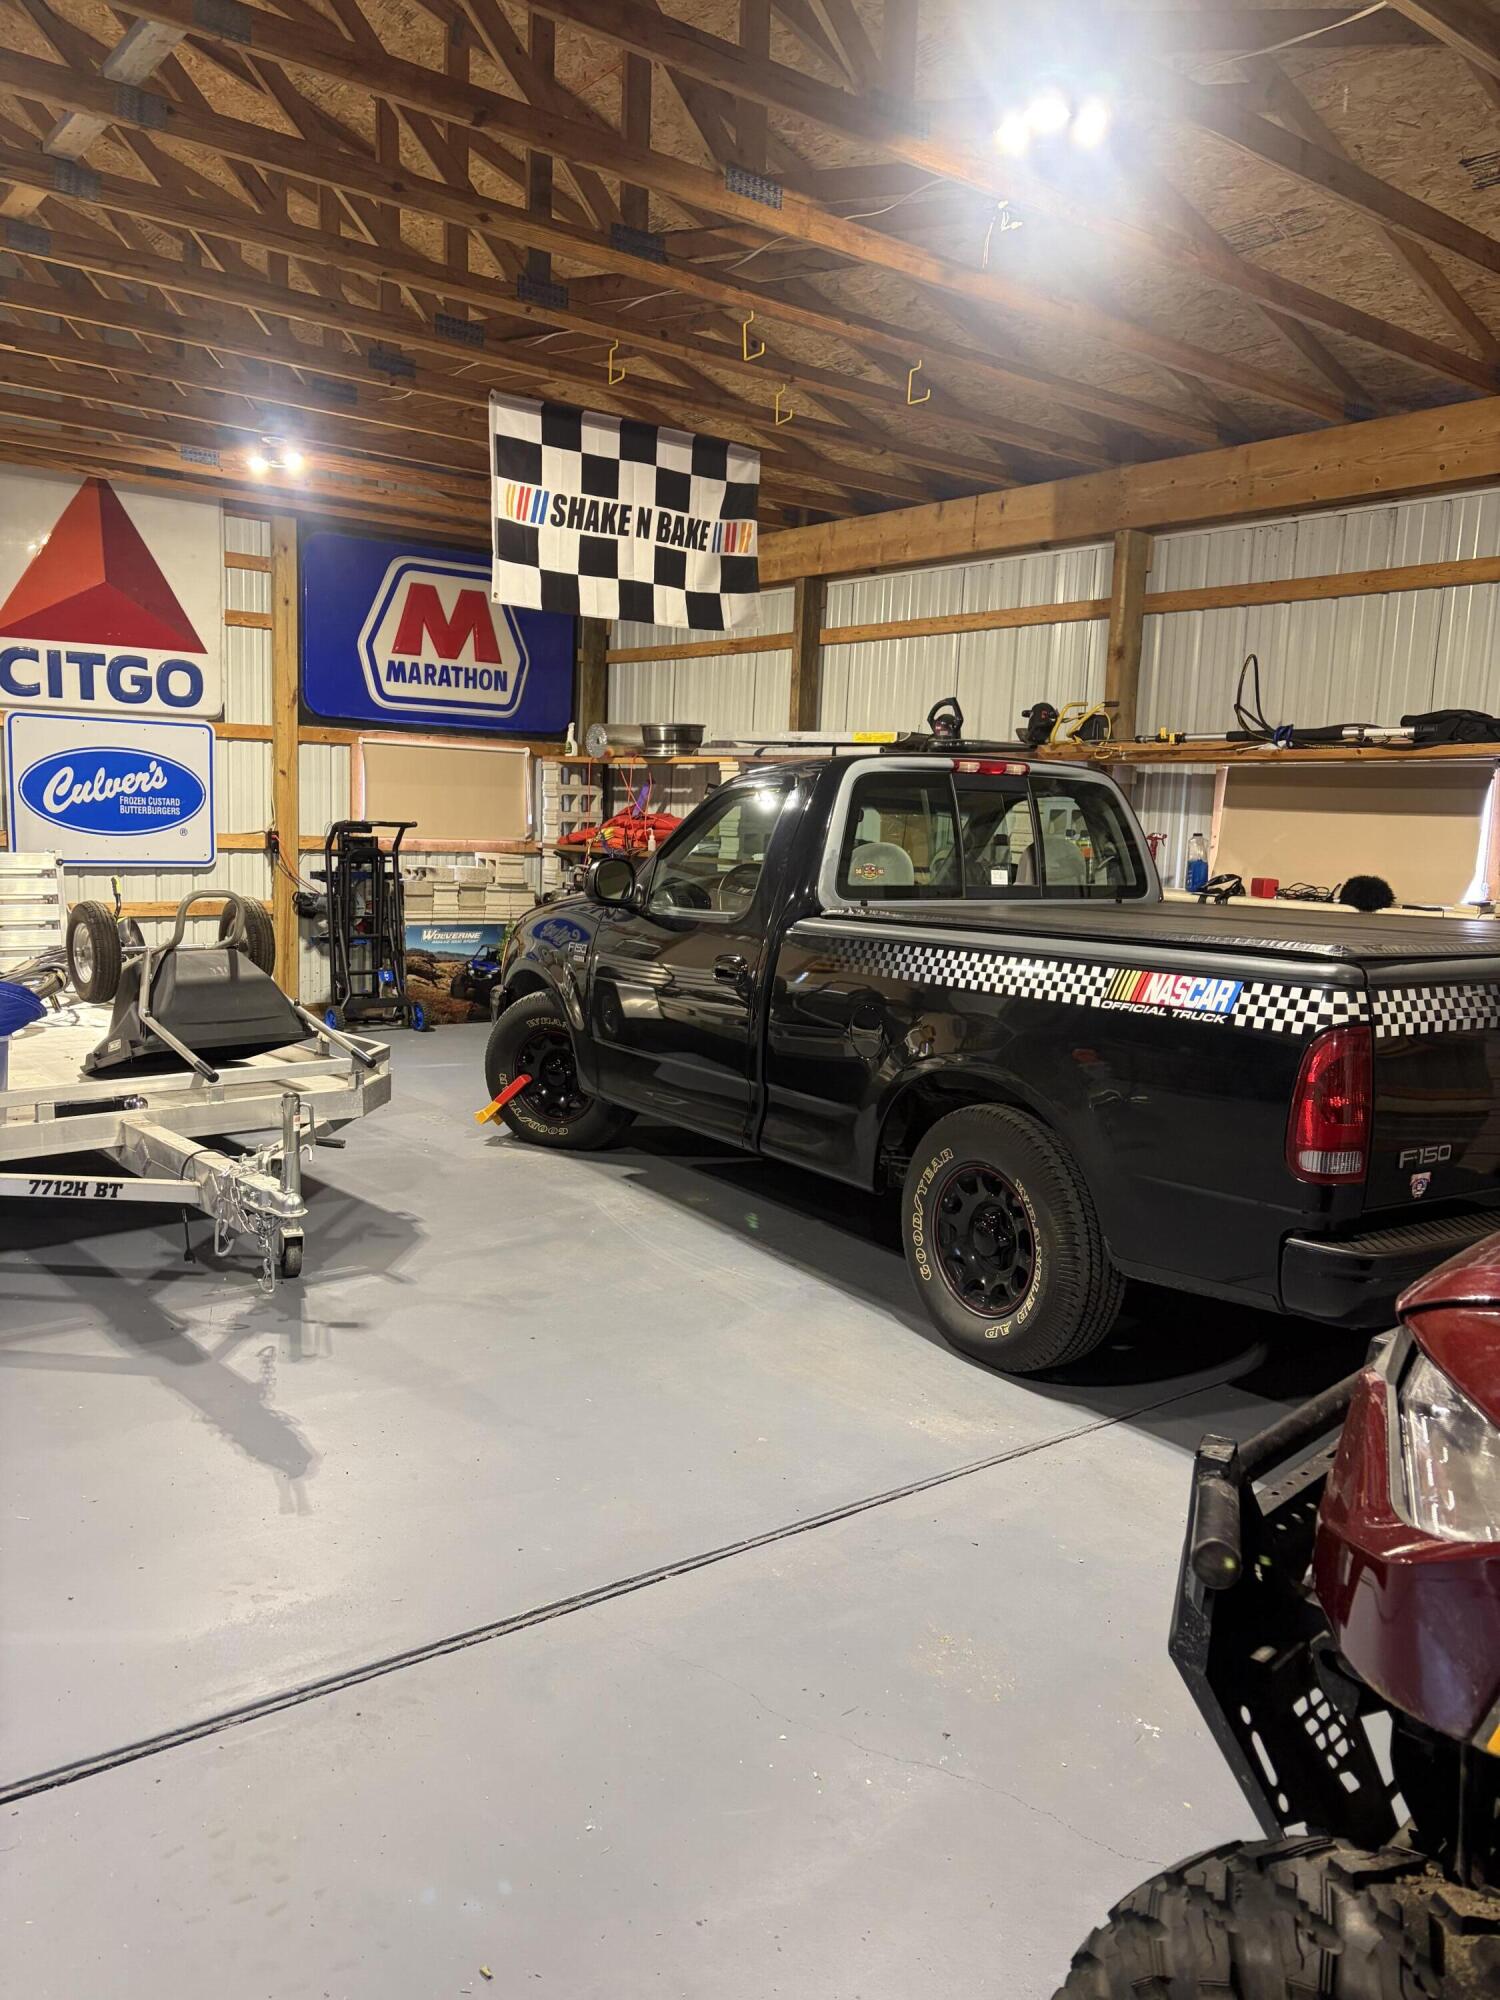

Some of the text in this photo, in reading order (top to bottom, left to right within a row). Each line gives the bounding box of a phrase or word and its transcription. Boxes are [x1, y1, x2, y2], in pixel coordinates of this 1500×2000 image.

[550, 493, 711, 552] SHAKE N BAKE
[0, 646, 204, 708] CITGO
[386, 660, 508, 692] MARATHON
[43, 760, 168, 814] Culver's
[119, 796, 181, 807] FROZEN CUSTARD
[422, 929, 483, 941] WOLVERINE
[1142, 972, 1237, 1013] NASCAR
[1101, 1000, 1229, 1024] OFFICIAL TRUCK
[29, 1180, 124, 1198] 7712H BT
[912, 1147, 954, 1281] GOODYEAR
